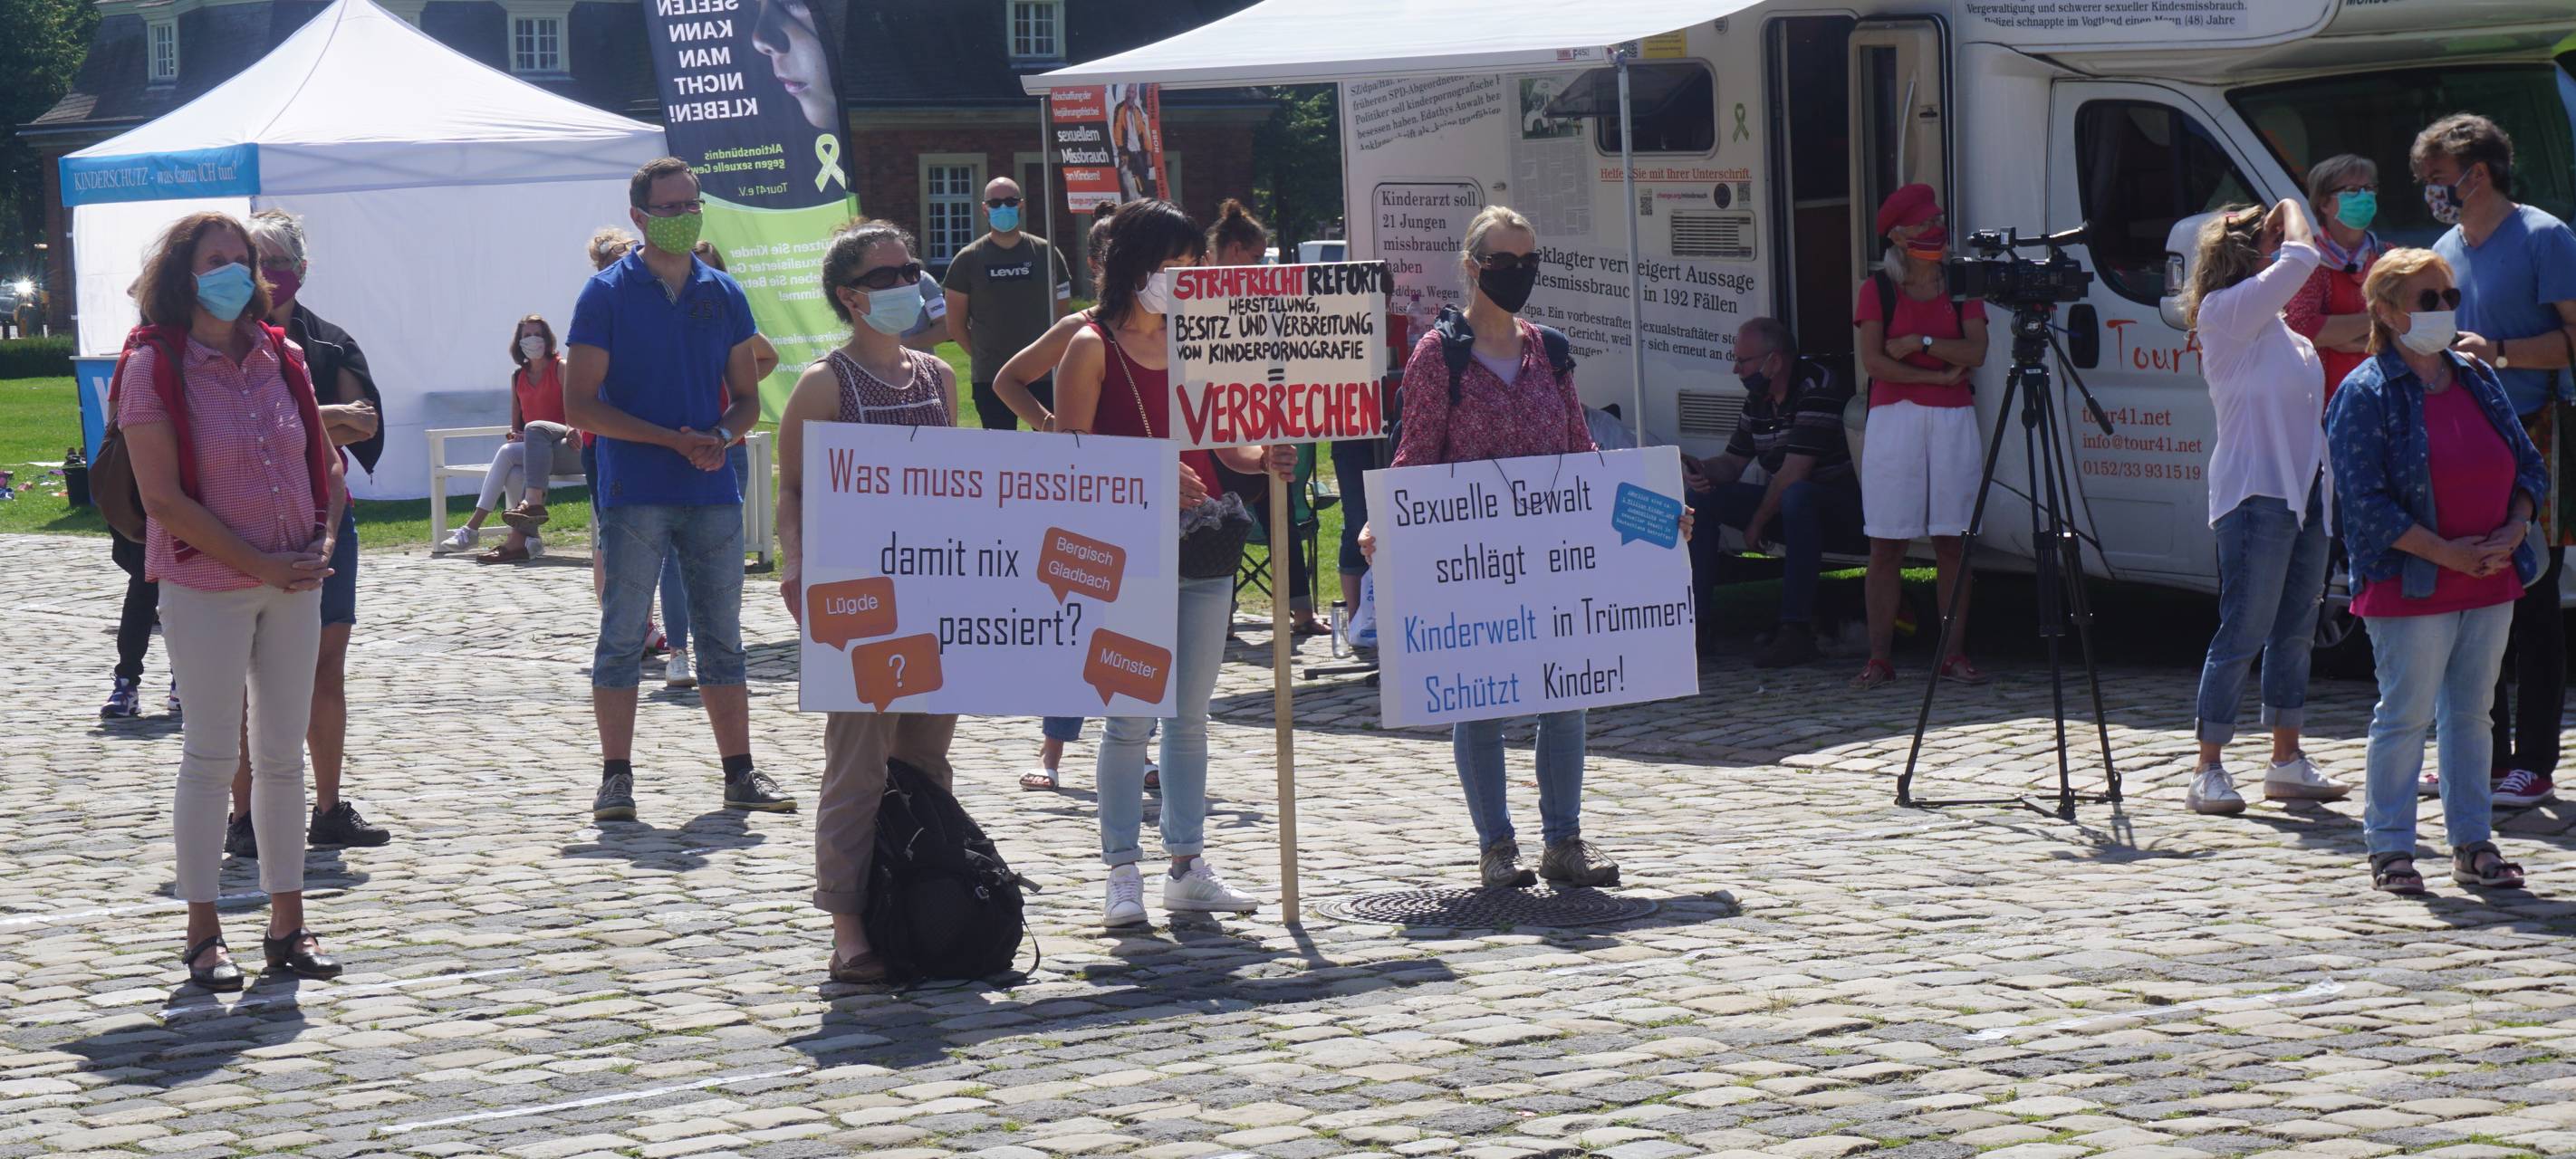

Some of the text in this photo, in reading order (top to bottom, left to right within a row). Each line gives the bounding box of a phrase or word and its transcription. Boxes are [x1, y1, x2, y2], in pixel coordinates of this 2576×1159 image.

[1966, 1, 2248, 16] Vergewaltigung und schwerer sexueller Kindesmissbrauch.
[2015, 16, 2065, 29] schnappte
[2067, 17, 2079, 26] im
[2184, 14, 2204, 27] (48)
[2206, 14, 2235, 25] Jahre
[1353, 94, 1388, 110] früheren
[1355, 108, 1389, 125] Politiker
[1390, 102, 1406, 115] soll
[1406, 78, 1495, 110] kinderpornografische
[1357, 123, 1392, 140] besessen
[1392, 116, 1419, 129] haben.
[1420, 106, 1454, 122] Edathys
[1455, 95, 1485, 110] Anwalt
[1057, 126, 1101, 142] sexuellem
[1062, 147, 1110, 164] Missbrauch
[73, 167, 149, 191] KINDERSCHUTZ
[157, 169, 174, 185] was
[174, 165, 197, 183] kann
[197, 163, 216, 181] ICH
[217, 160, 237, 180] tun?
[1632, 168, 1647, 179] Sie
[1649, 168, 1665, 179] mit
[1667, 168, 1690, 179] Ihrer
[1692, 168, 1753, 180] Unterschrift.
[1381, 190, 1476, 207] Kinderarzt soll
[1382, 214, 1447, 233] 21 Jungen
[1383, 236, 1461, 253] missbraucht
[1386, 258, 1423, 274] haben
[1536, 246, 1595, 273] eklagter
[1686, 265, 1755, 294] Aussage
[1173, 266, 1306, 301] STRAFRECHT
[1427, 285, 1459, 302] Wegen
[1643, 284, 1658, 302] in
[1663, 288, 1688, 307] 192
[1694, 292, 1738, 314] Fällen
[1228, 295, 1321, 316] HERSTELLUNG,
[1548, 306, 1565, 320] Ein
[1175, 311, 1374, 342] BESITZ UND VERBREITUNG
[1208, 340, 1364, 365] KINDERPORNOGRAFIE
[1568, 326, 1610, 345] Gericht,
[1611, 333, 1631, 347] weil
[1648, 338, 1670, 353] sich
[1709, 350, 1723, 360] an
[2082, 433, 2203, 454] info@tour41.net
[828, 447, 1149, 510] Was muss passieren,
[1394, 475, 1592, 527] Sexuelle Gewalt
[879, 531, 1020, 578] damit nix
[1056, 535, 1114, 566] Bergisch
[1437, 540, 1597, 585] schlägt eine
[1048, 559, 1111, 591] Gladbach
[825, 592, 879, 618] Lügde
[1404, 585, 1695, 654] Kinderwelt in Trümmer!
[938, 602, 1082, 656] passiert?
[888, 653, 907, 689] ?
[1100, 647, 1158, 679] Münster
[1425, 655, 1625, 714] Schützt Kinder!
